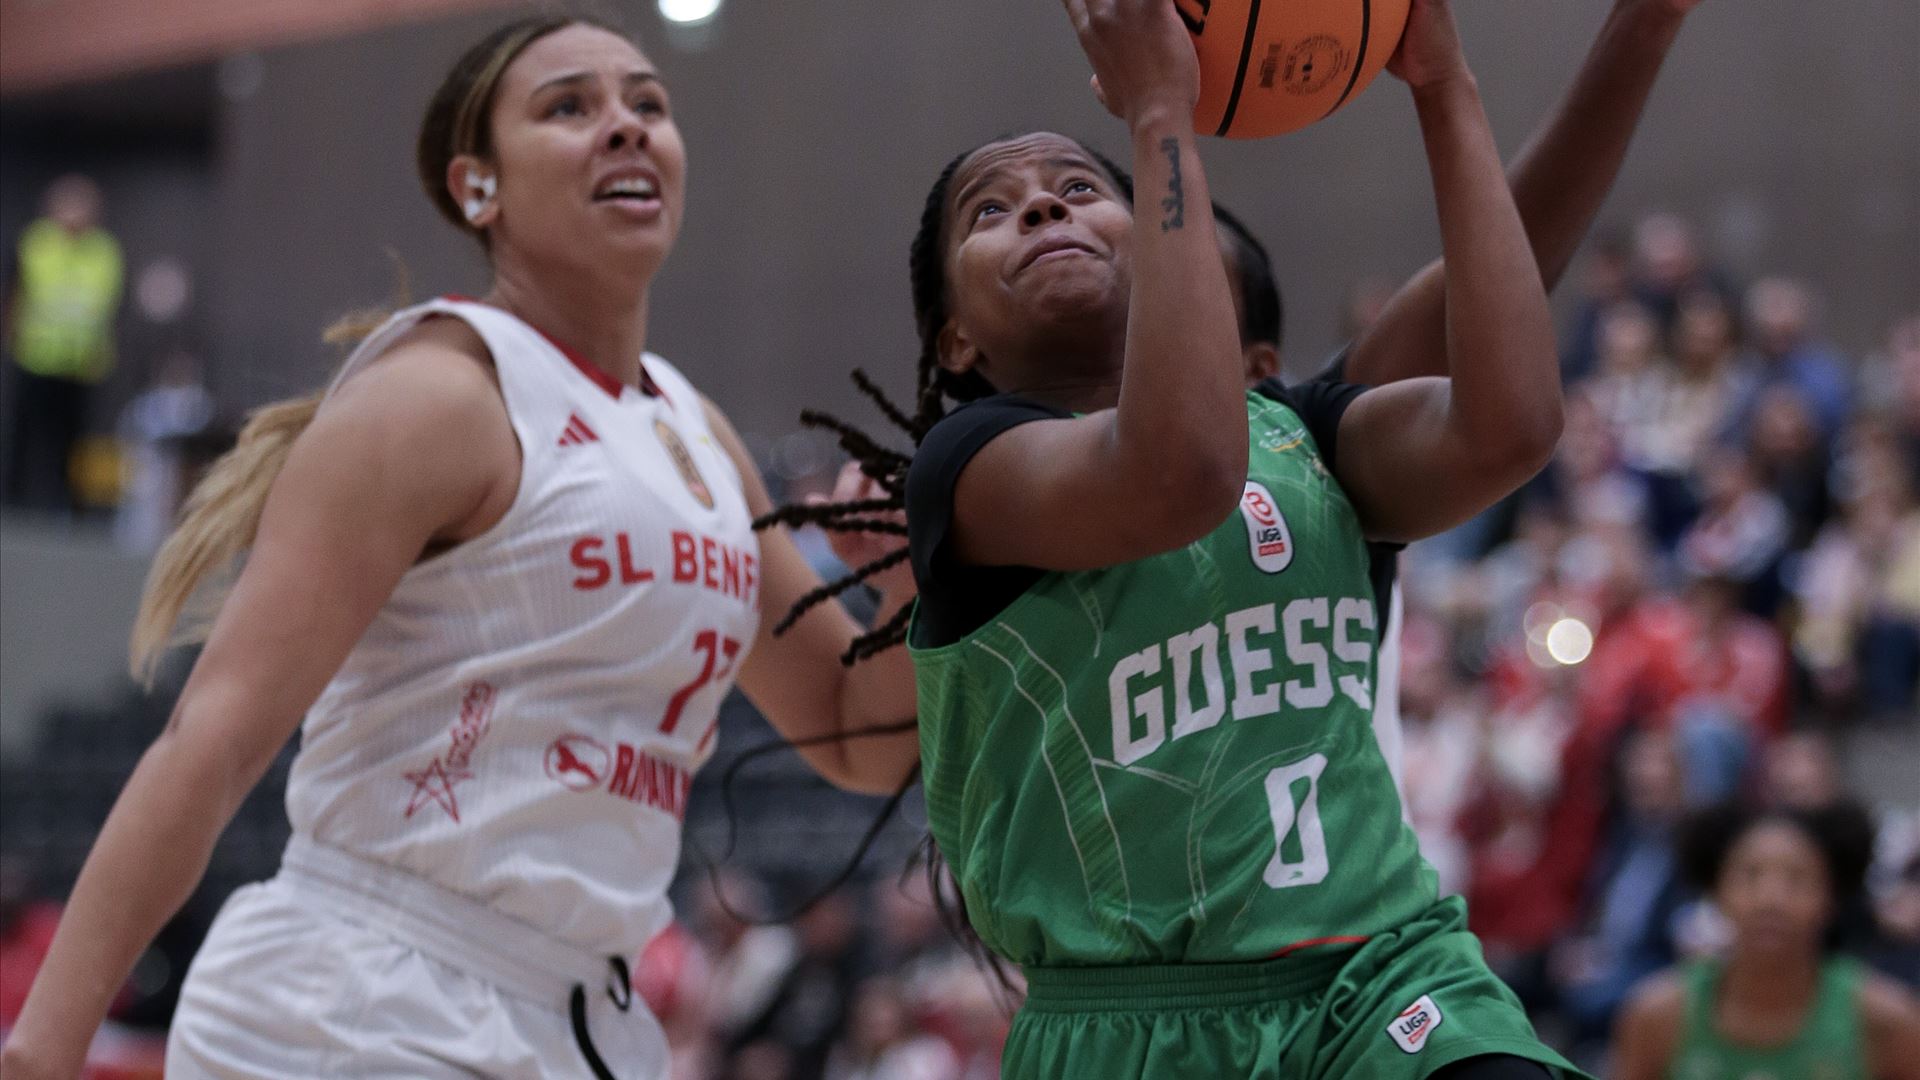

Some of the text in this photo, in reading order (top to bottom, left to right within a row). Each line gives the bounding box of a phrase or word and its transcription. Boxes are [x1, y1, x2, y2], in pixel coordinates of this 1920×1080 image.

[570, 532, 655, 590] SL
[1108, 597, 1373, 768] GDESS
[1263, 752, 1330, 889] 0
